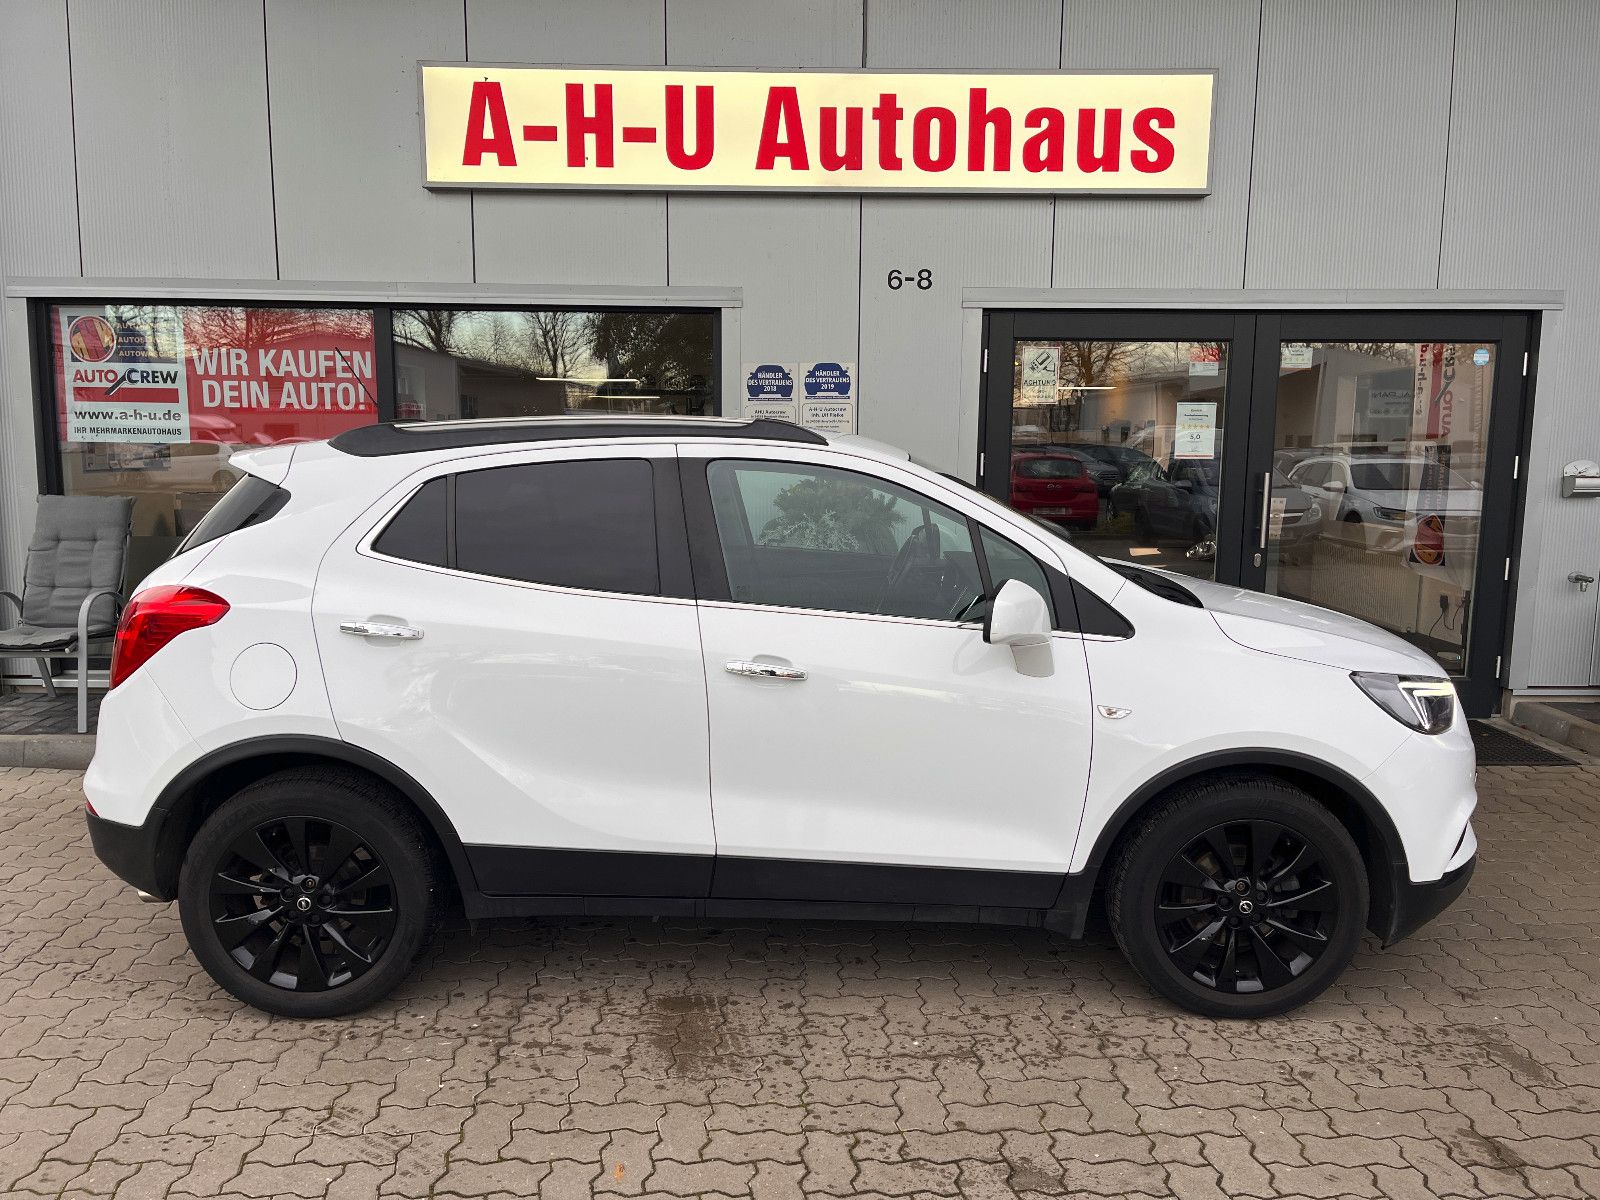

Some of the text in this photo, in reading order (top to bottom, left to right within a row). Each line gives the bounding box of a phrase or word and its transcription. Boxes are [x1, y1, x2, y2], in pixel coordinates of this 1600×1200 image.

[463, 82, 1175, 173] A-H-U Autohaus
[887, 269, 933, 290] 6-8
[193, 347, 372, 379] WIR KAUFEN
[72, 369, 179, 384] AUTO CREW
[815, 369, 840, 377] HÄNDLER
[202, 380, 366, 410] DEIN AUTO!
[73, 409, 182, 421] www.a-h-u.de
[74, 426, 182, 436] IHR MEHRMARKENAUTOHAUS
